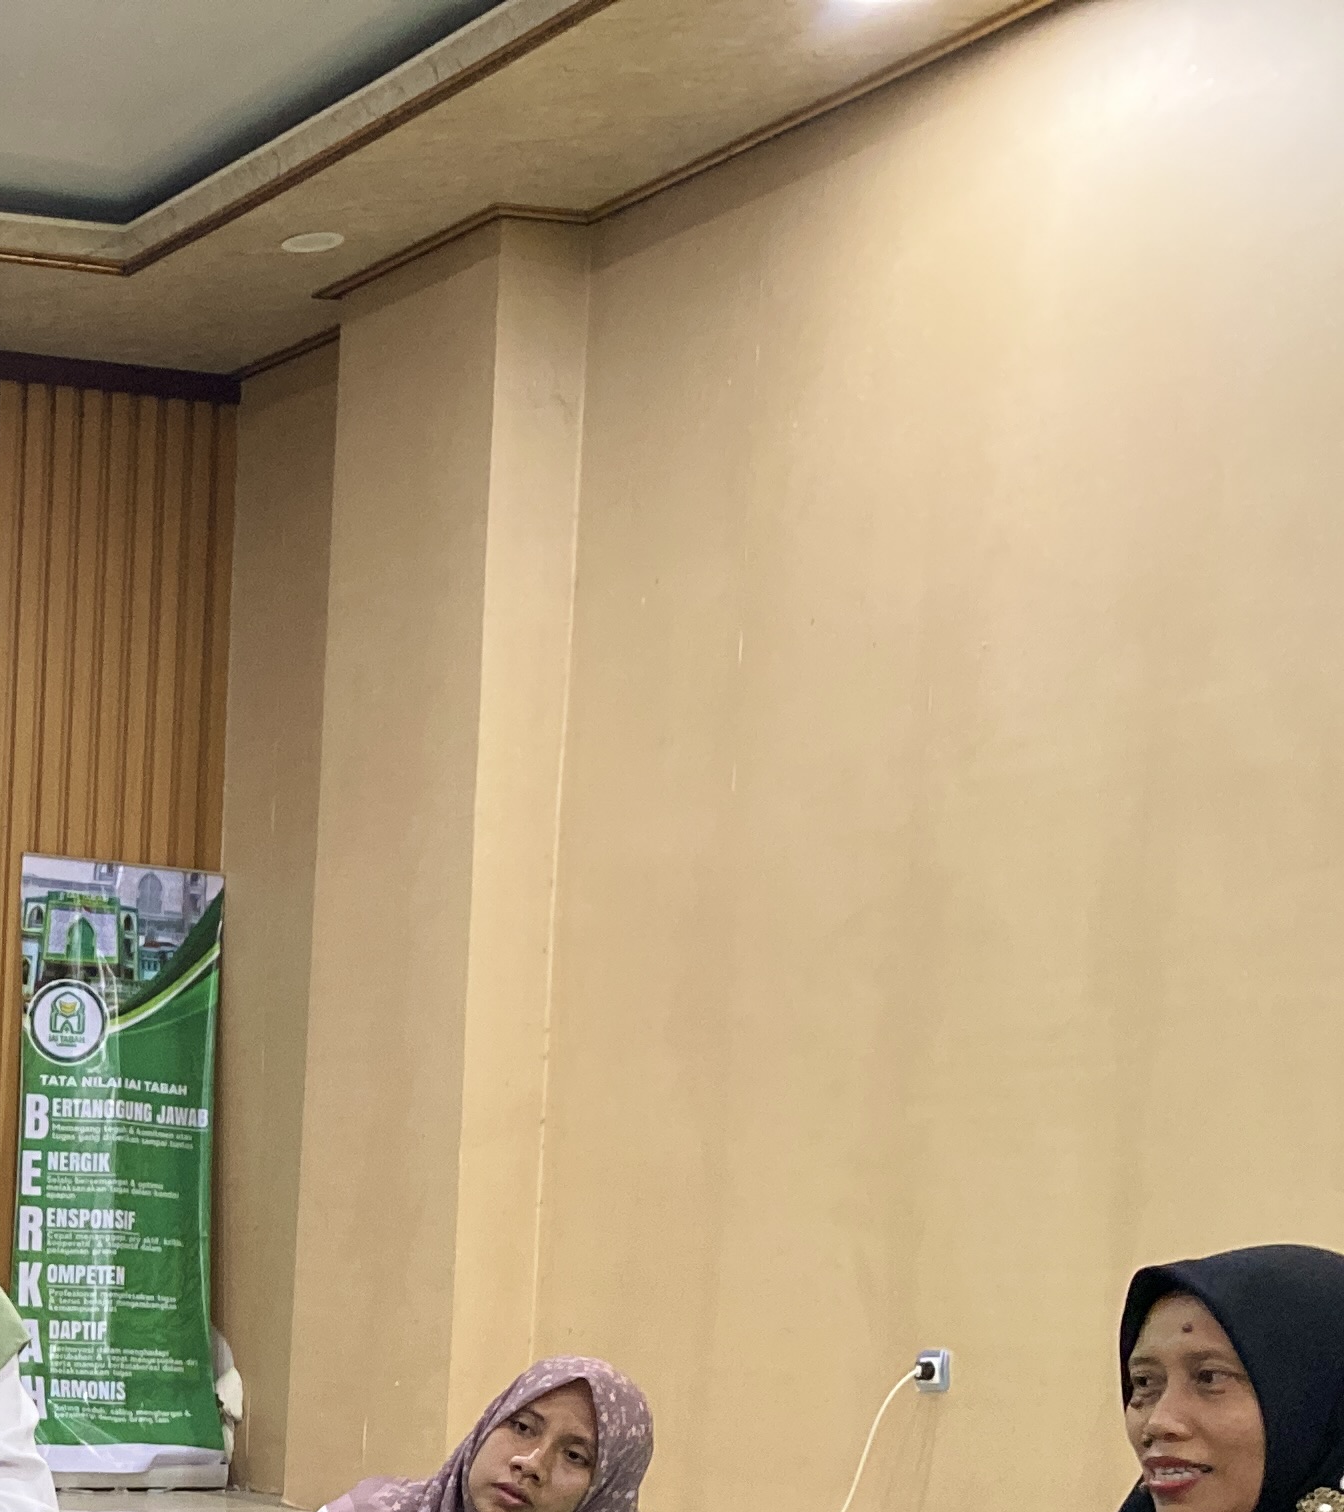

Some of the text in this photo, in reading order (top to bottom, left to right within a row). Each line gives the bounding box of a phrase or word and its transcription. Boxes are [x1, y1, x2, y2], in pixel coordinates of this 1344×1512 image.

[39, 1074, 78, 1087] TATA
[81, 1076, 122, 1089] NILAI
[144, 1081, 188, 1096] TABAH
[157, 1105, 208, 1128] JAWAB
